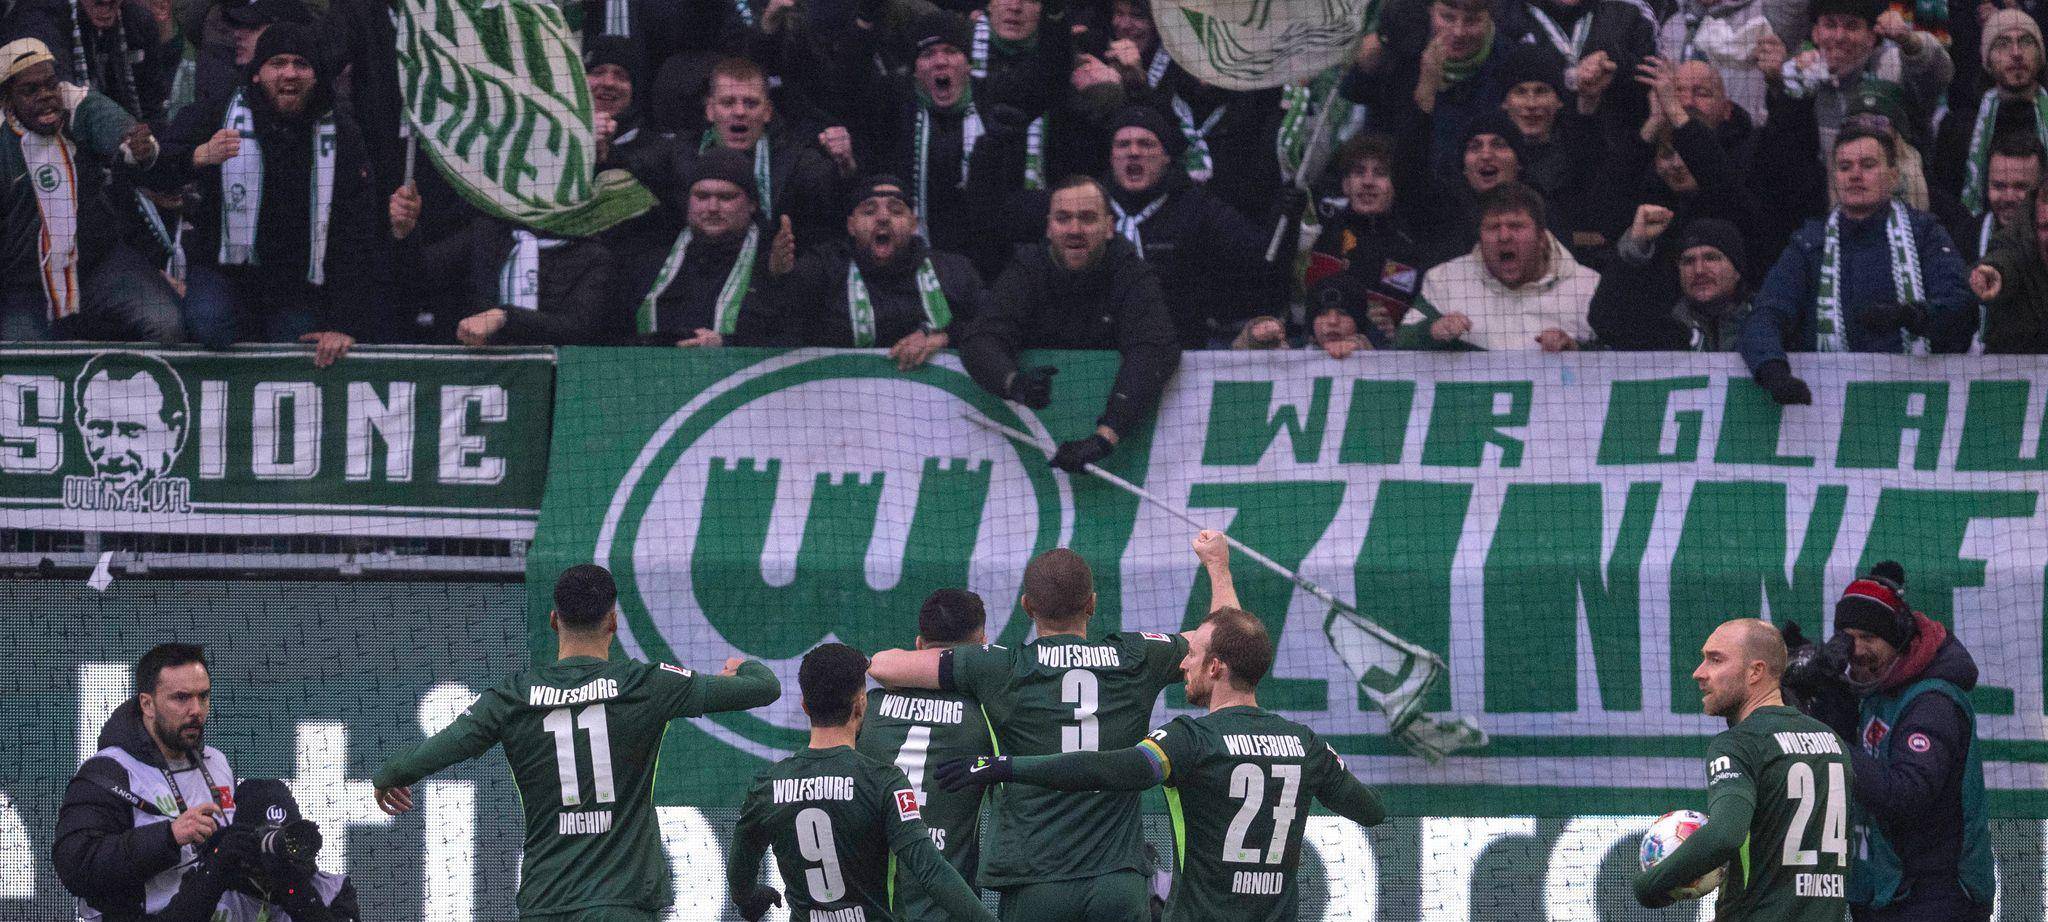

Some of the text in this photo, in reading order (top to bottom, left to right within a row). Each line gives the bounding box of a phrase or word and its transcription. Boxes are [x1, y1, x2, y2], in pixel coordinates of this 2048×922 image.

[1201, 376, 2048, 472] WIR GLAU
[1164, 479, 2048, 717] ZINNE
[1037, 643, 1120, 669] WOLFSBURG
[529, 677, 620, 706] WOLFSBURG
[879, 693, 963, 725] WOLFSBURG
[1061, 668, 1099, 753] 3
[542, 703, 616, 806] 11
[1222, 734, 1306, 758] WOLFSBURG
[1773, 731, 1843, 756] WOLFSBURG
[772, 776, 854, 804] WOLFSBURG
[558, 810, 613, 835] DAGHIM
[1222, 762, 1301, 865] 27
[1782, 761, 1848, 867] 24
[795, 807, 846, 903] 9
[1231, 871, 1284, 895] ARNOLD
[1795, 872, 1845, 898] ERIKSEN
